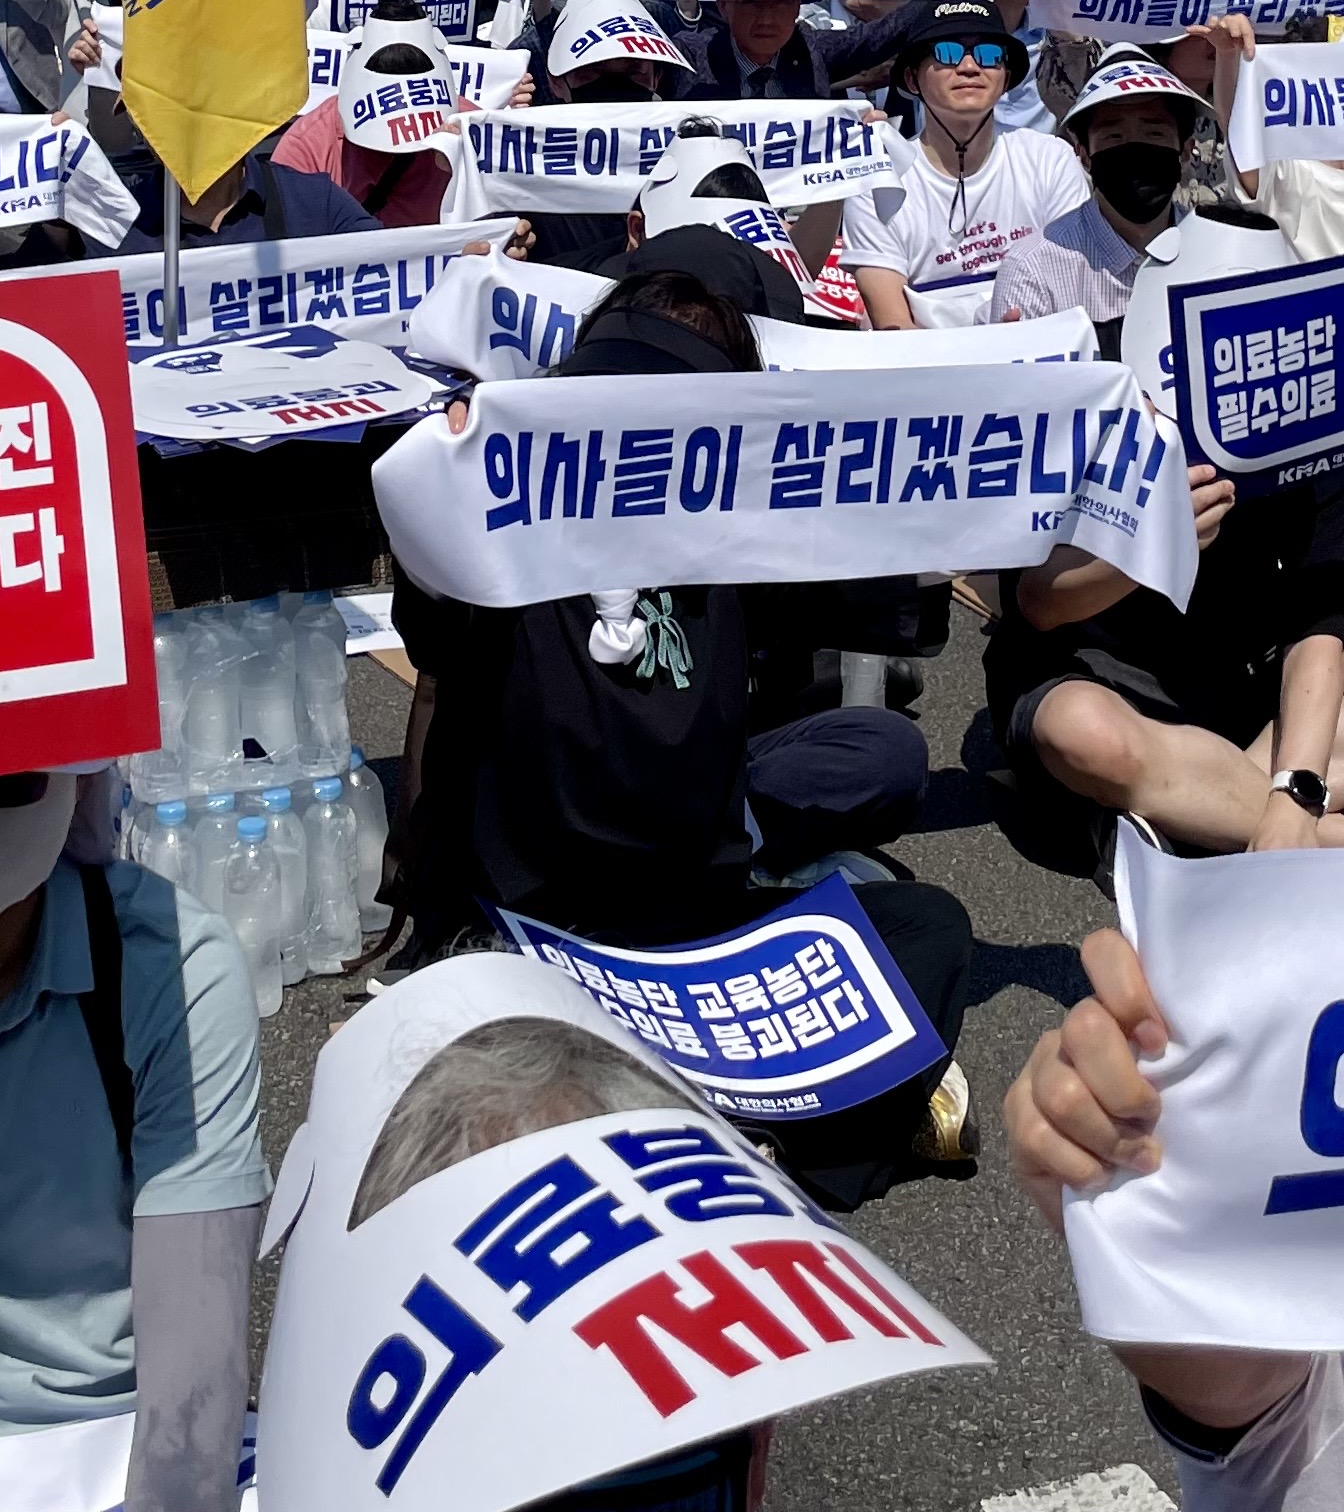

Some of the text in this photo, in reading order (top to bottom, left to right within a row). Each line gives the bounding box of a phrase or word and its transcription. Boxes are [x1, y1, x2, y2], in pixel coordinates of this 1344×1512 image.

[569, 15, 662, 60] 의료붕
[353, 78, 453, 129] 의료붕괴
[470, 118, 619, 177] 의사들이
[803, 168, 844, 186] KMA
[935, 249, 957, 266] get
[959, 235, 1007, 261] through
[963, 221, 997, 238] Let's
[210, 254, 446, 333] 살리겠습니
[1213, 320, 1337, 389] 의료농단
[186, 379, 402, 419] 의료붕괴
[268, 397, 389, 426] 저지
[1216, 373, 1336, 443] 필수의료
[483, 406, 1167, 533] 의사들이 살리겠습니다!
[1278, 457, 1330, 486] KMA
[541, 937, 843, 1026] 의료농단 교육농단
[598, 979, 870, 1061] 수의료 붕괴된다
[346, 1124, 806, 1498] 의료붕
[573, 1239, 946, 1420] 저지
